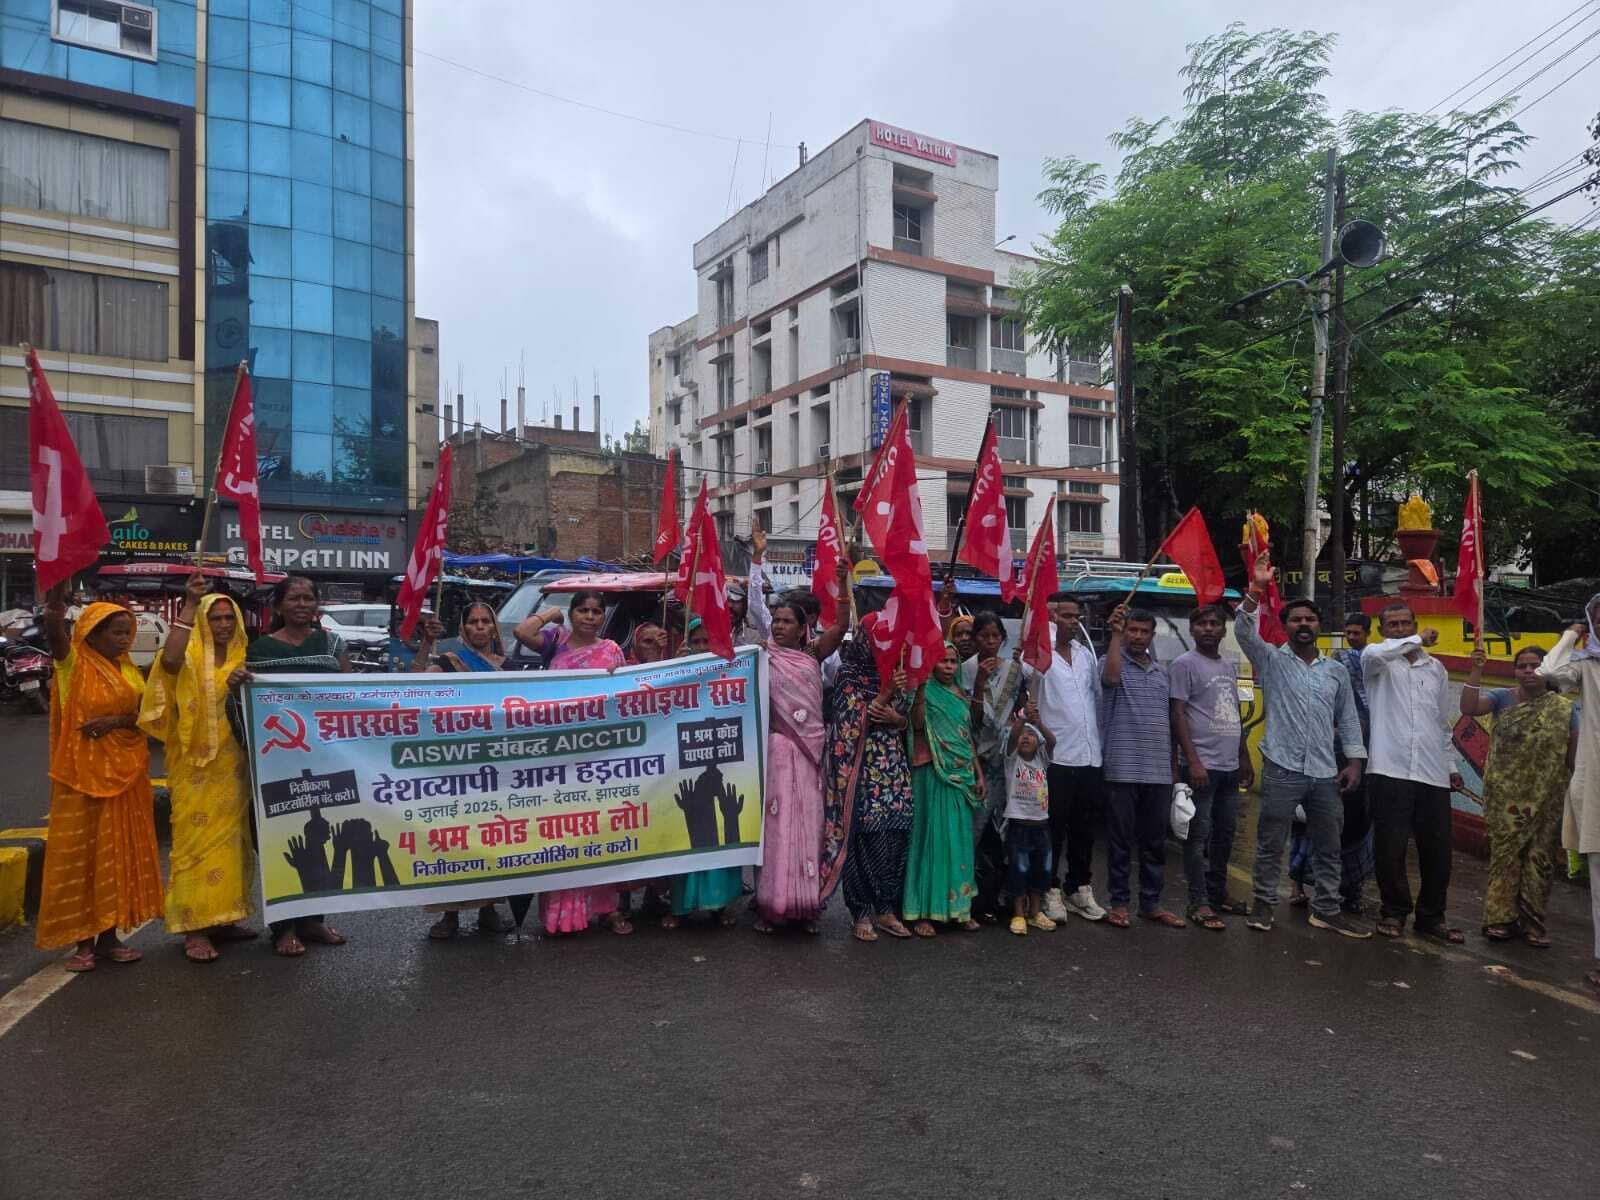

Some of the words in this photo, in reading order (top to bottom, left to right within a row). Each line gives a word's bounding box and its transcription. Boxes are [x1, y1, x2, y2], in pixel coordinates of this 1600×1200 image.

[876, 127, 912, 148] HOTEL
[914, 136, 953, 160] YATRIK
[227, 523, 294, 540] HTEL
[228, 547, 342, 569] GNPATI
[351, 550, 390, 569] INN
[314, 702, 421, 742] झारखंड
[429, 705, 494, 735] राज्य
[708, 672, 747, 706] संघ
[399, 743, 480, 764] AISWF
[487, 737, 550, 758] संबद्ध
[554, 726, 641, 752] AICCTU
[694, 728, 714, 742] श्रम
[716, 723, 738, 739] कोड
[684, 746, 715, 761] वापस
[289, 780, 331, 796] निजीकरण
[371, 765, 500, 805] देशव्यापी
[510, 765, 567, 790] आम
[575, 754, 666, 785] हड़ताल
[404, 809, 413, 821] 9
[418, 800, 459, 823] जुलाई
[596, 784, 641, 802] झारखंड
[427, 825, 470, 853] श्रम
[477, 814, 530, 847] कोड
[536, 811, 600, 840] वापस
[608, 800, 650, 832] लो।
[496, 844, 580, 869] आउटसोर्सिंग
[584, 842, 602, 858] बंद
